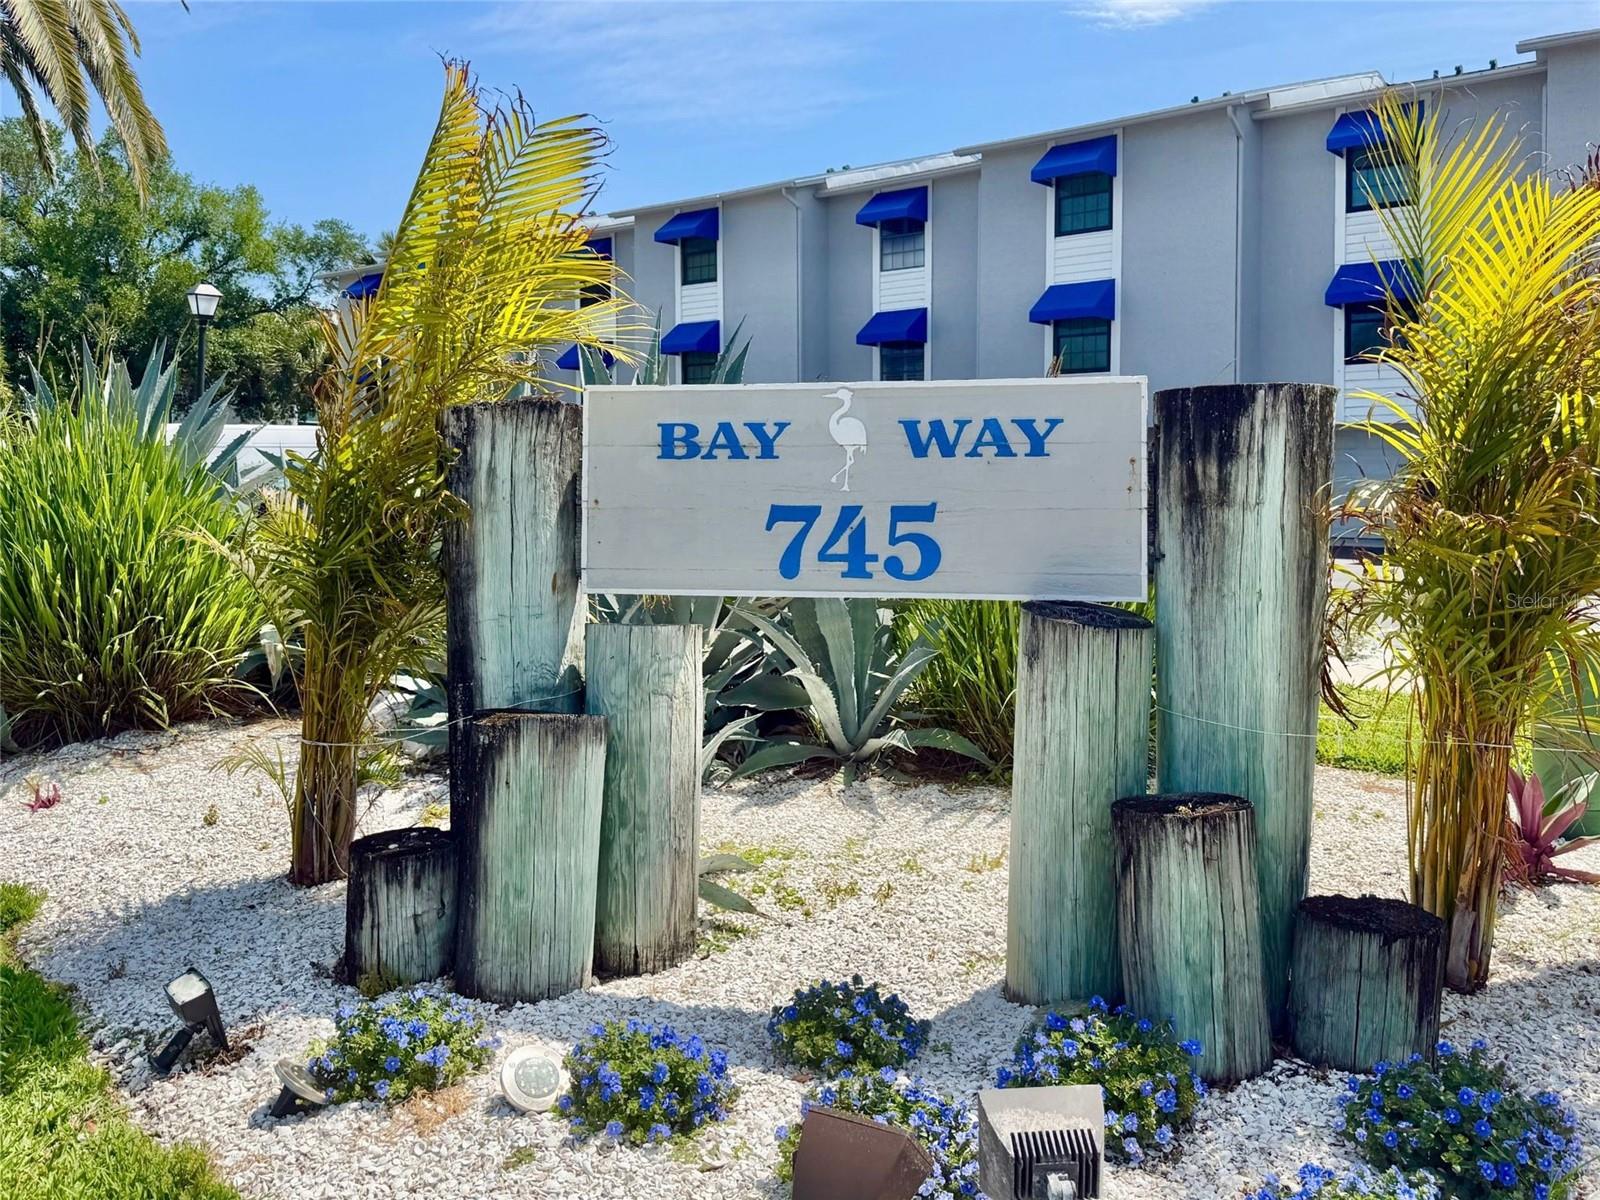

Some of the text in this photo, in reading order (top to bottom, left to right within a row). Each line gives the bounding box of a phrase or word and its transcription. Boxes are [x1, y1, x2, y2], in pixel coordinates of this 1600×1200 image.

[657, 417, 1064, 460] BAY WAY
[765, 501, 942, 581] 745
